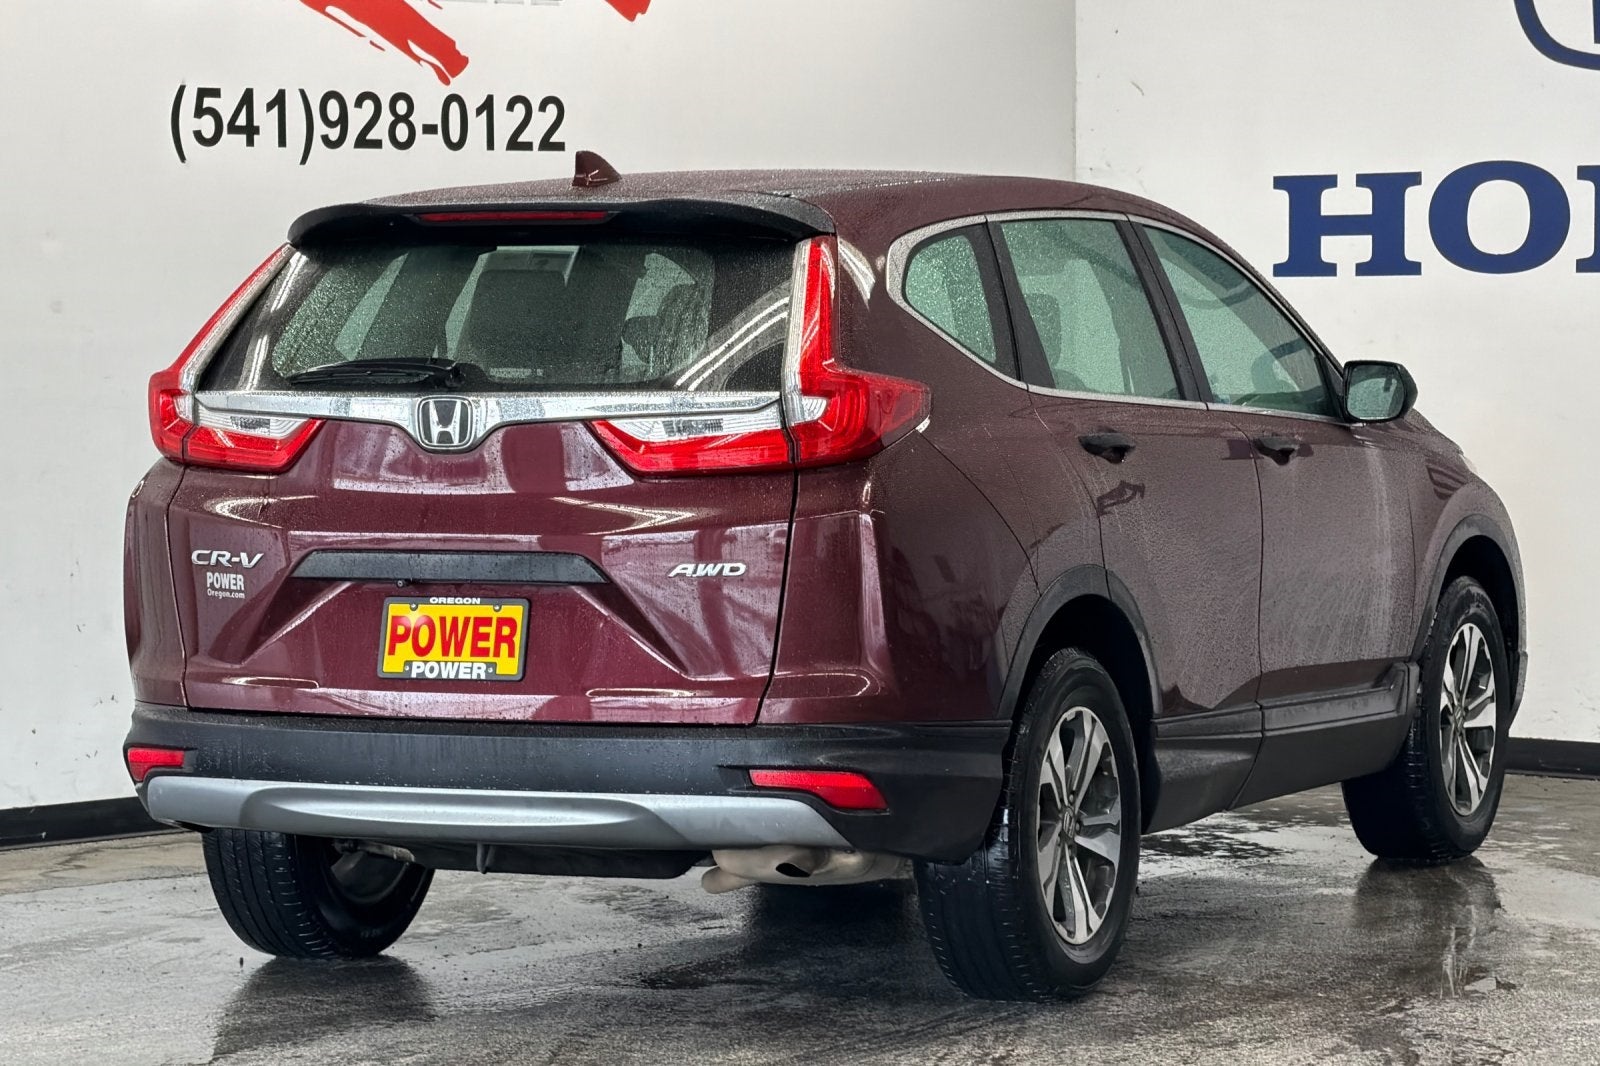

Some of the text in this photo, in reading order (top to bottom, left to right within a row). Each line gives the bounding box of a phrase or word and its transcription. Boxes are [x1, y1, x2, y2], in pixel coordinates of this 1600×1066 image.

[170, 83, 566, 165] (541)928-0122
[1273, 160, 1600, 277] HO
[191, 550, 264, 568] CR-V
[668, 562, 747, 577] AWD
[206, 572, 245, 590] POWER
[207, 588, 246, 599] Oregon.com
[429, 597, 481, 605] OREGON
[387, 614, 518, 658] POWER
[410, 661, 487, 680] POWER
